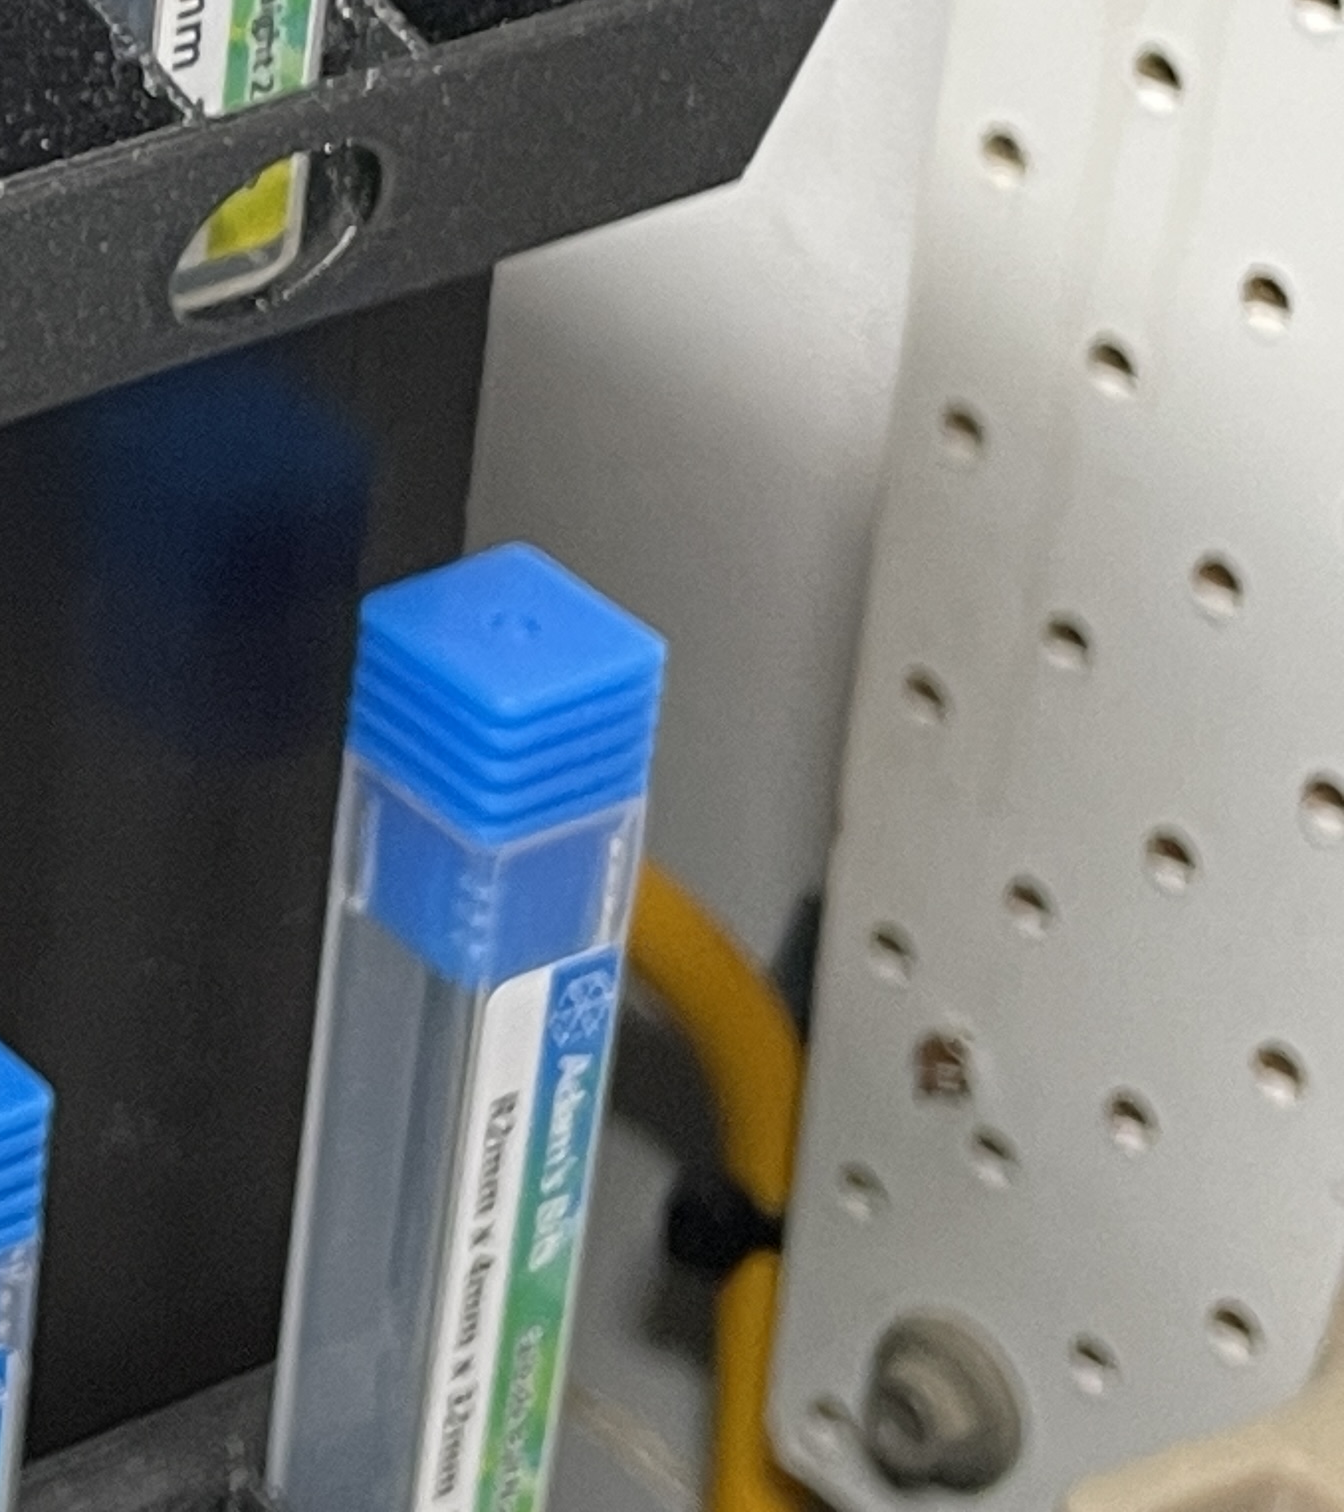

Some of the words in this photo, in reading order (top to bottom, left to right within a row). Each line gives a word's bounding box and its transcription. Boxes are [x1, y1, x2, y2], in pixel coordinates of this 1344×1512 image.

[250, 74, 275, 102] 2
[539, 1053, 594, 1195] Adam's
[469, 1220, 496, 1251] x
[527, 1193, 572, 1273] Bits
